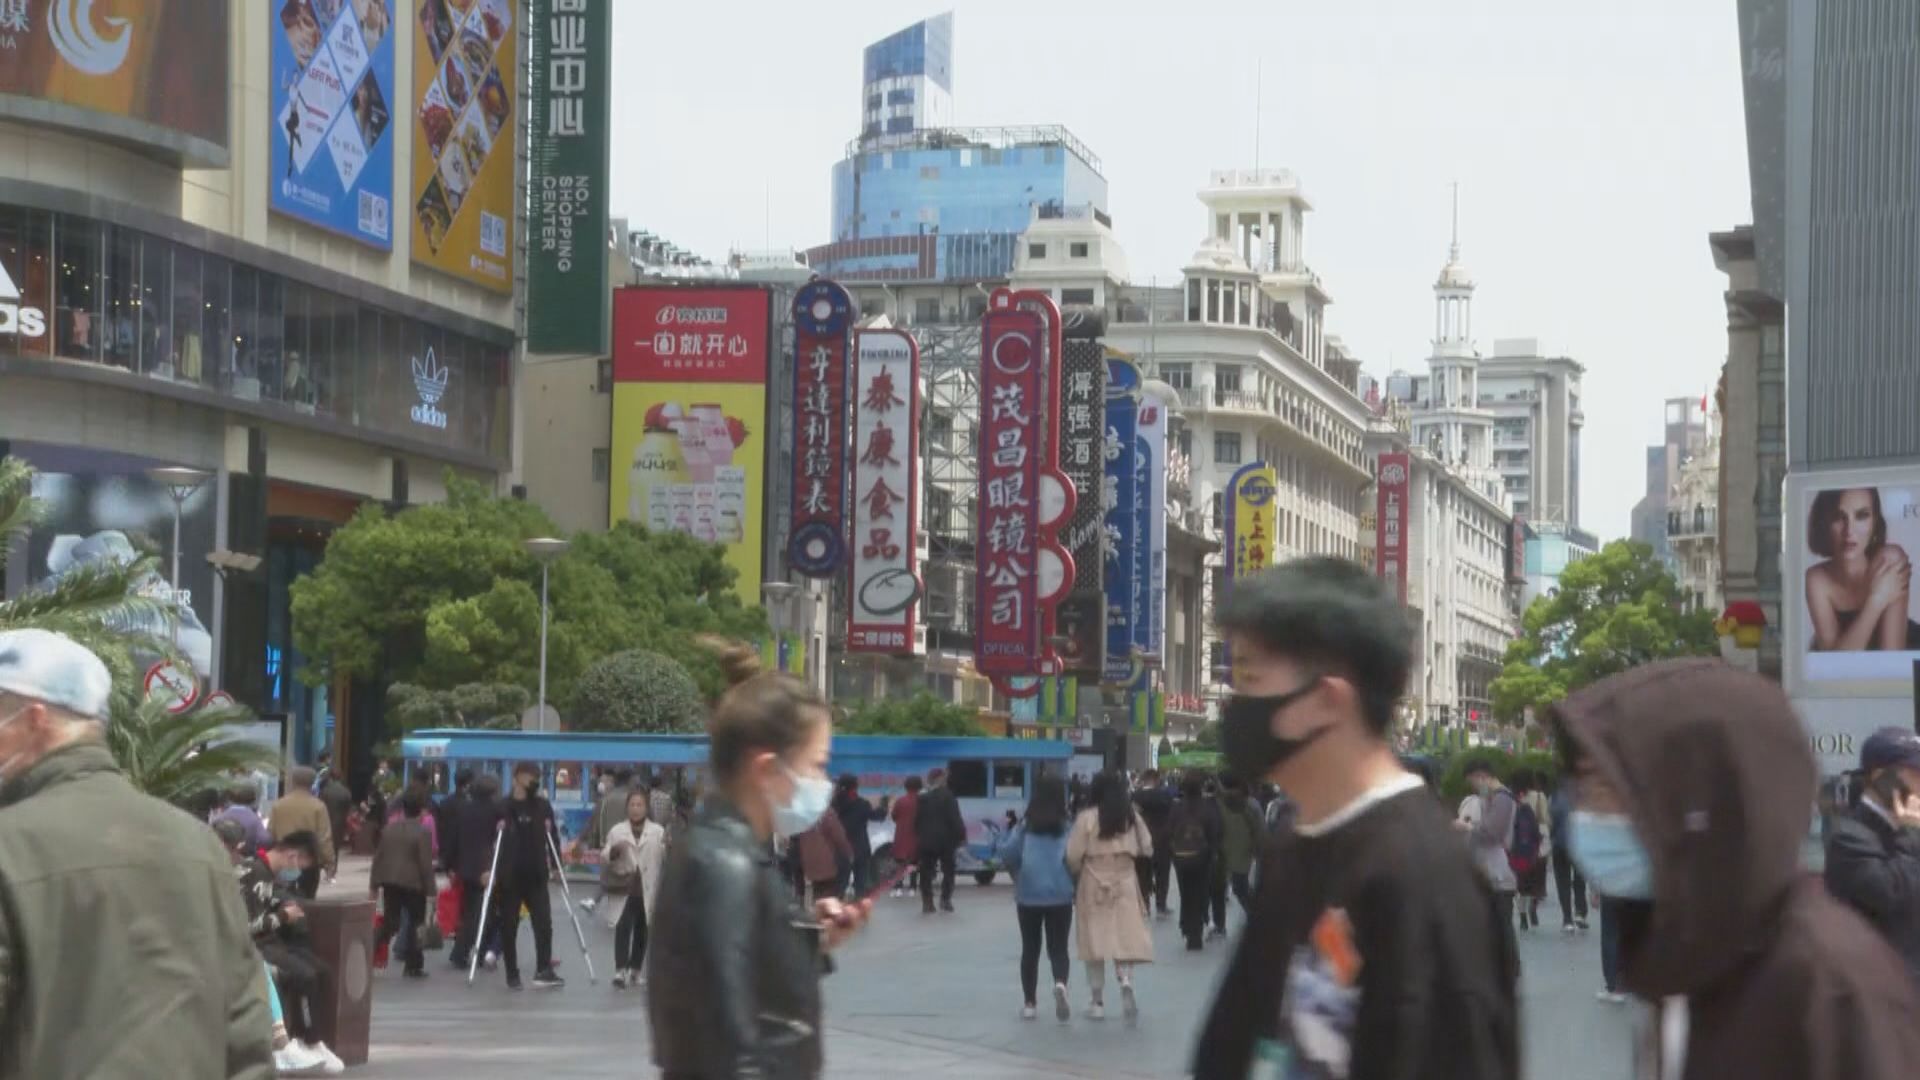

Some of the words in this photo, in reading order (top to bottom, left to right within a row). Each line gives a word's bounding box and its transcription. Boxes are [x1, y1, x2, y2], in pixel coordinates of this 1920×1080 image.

[542, 175, 557, 251] CENTER
[558, 175, 573, 273] SHOPPING
[575, 175, 589, 216] NO.1
[411, 404, 447, 429] adidas
[860, 363, 905, 560] 泰康食品
[985, 382, 1029, 630] 茂昌眼镜公司
[983, 643, 1026, 655] OPTICAL
[1810, 733, 1855, 755] IOR
